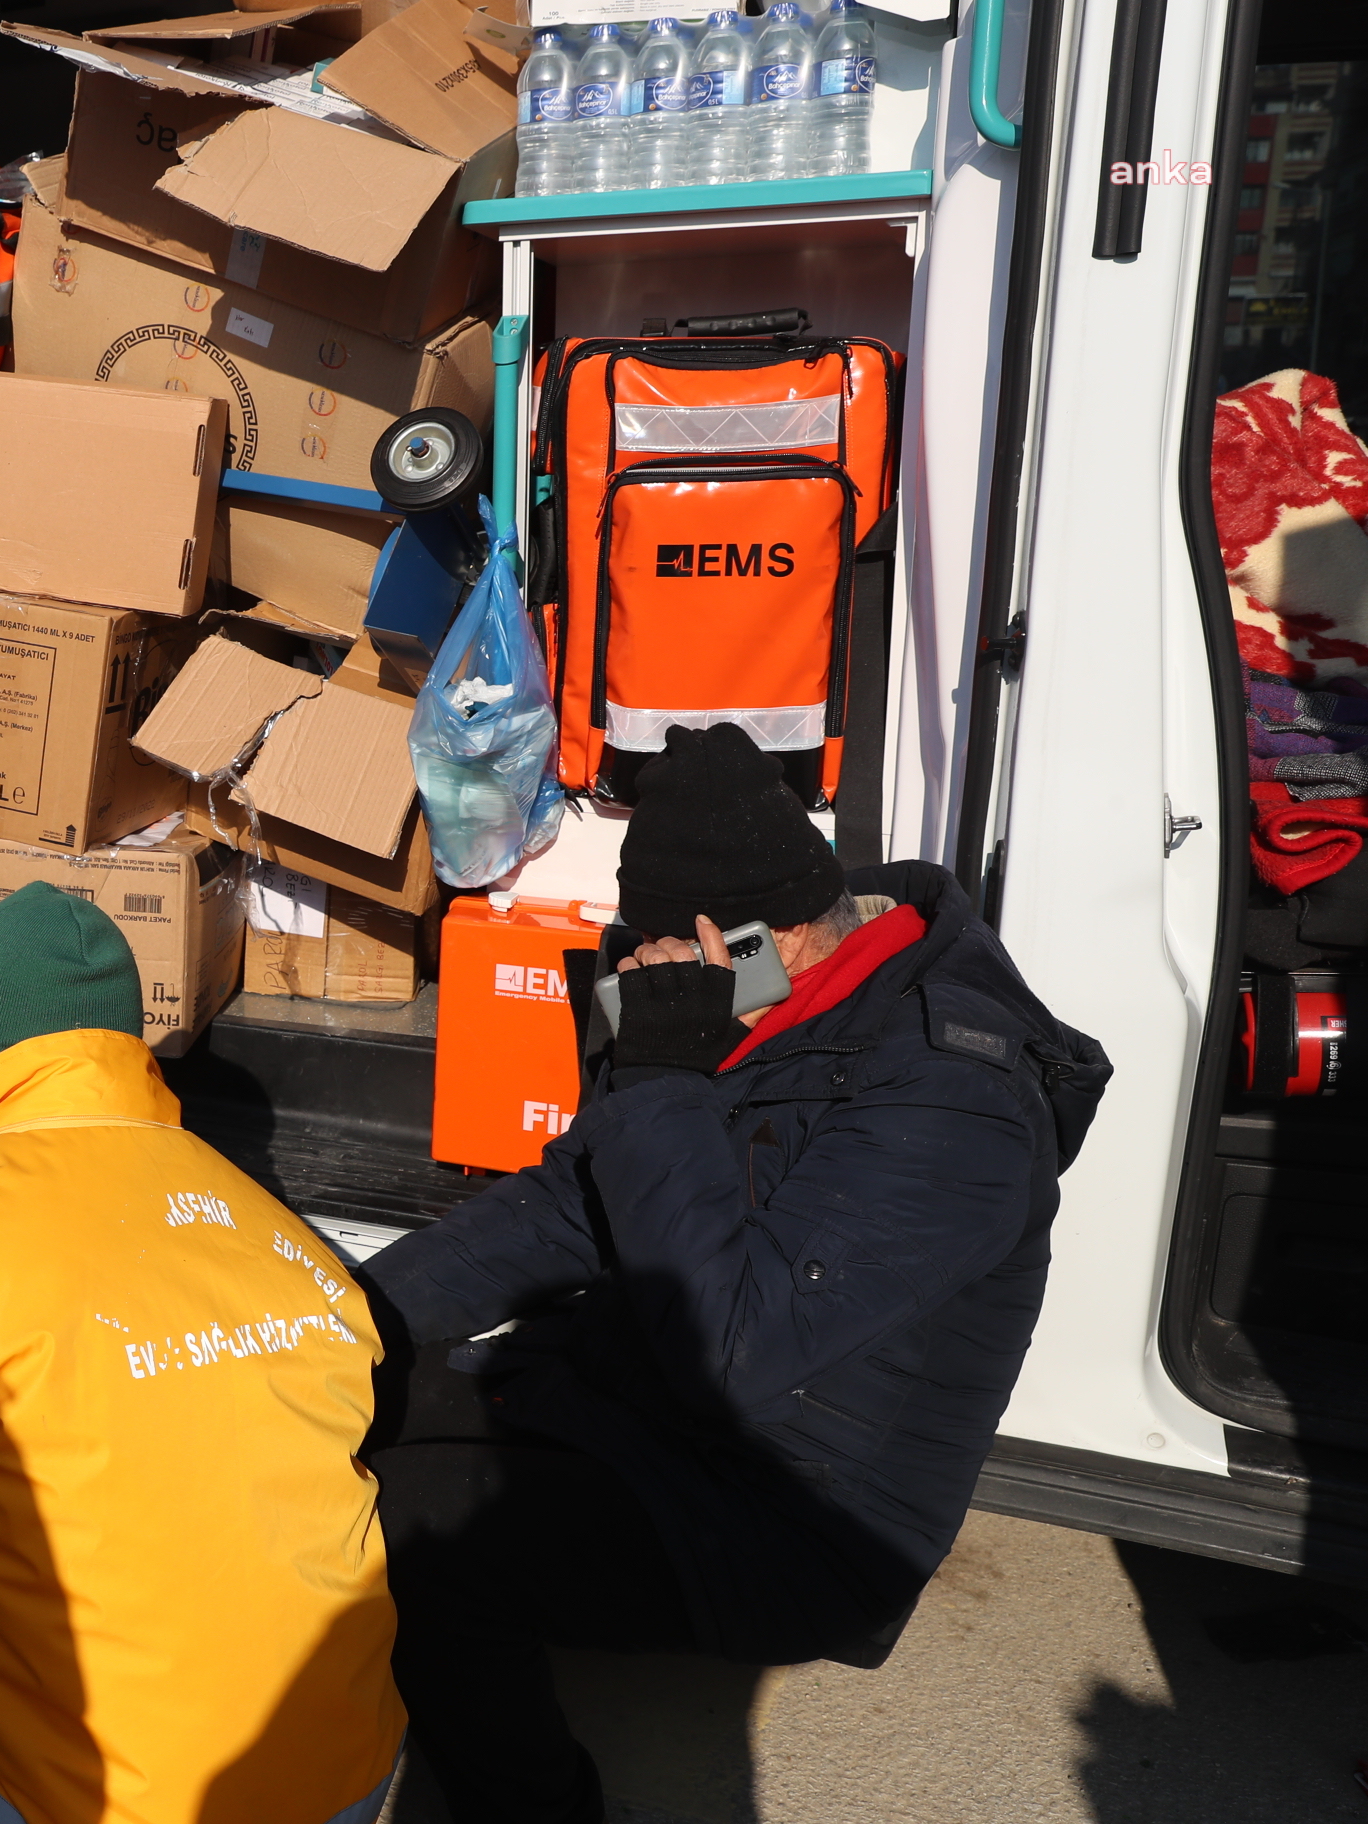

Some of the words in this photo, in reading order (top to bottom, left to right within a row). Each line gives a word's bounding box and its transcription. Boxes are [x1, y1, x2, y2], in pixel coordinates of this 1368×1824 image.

[697, 542, 795, 578] EMS
[32, 625, 48, 635] 1440
[50, 628, 61, 638] ML
[68, 631, 74, 640] 9
[75, 632, 96, 644] ADET
[113, 914, 148, 924] BARKODU
[148, 916, 172, 924] PAKET
[494, 990, 538, 1001] Emergency
[539, 995, 565, 1004] Mobile
